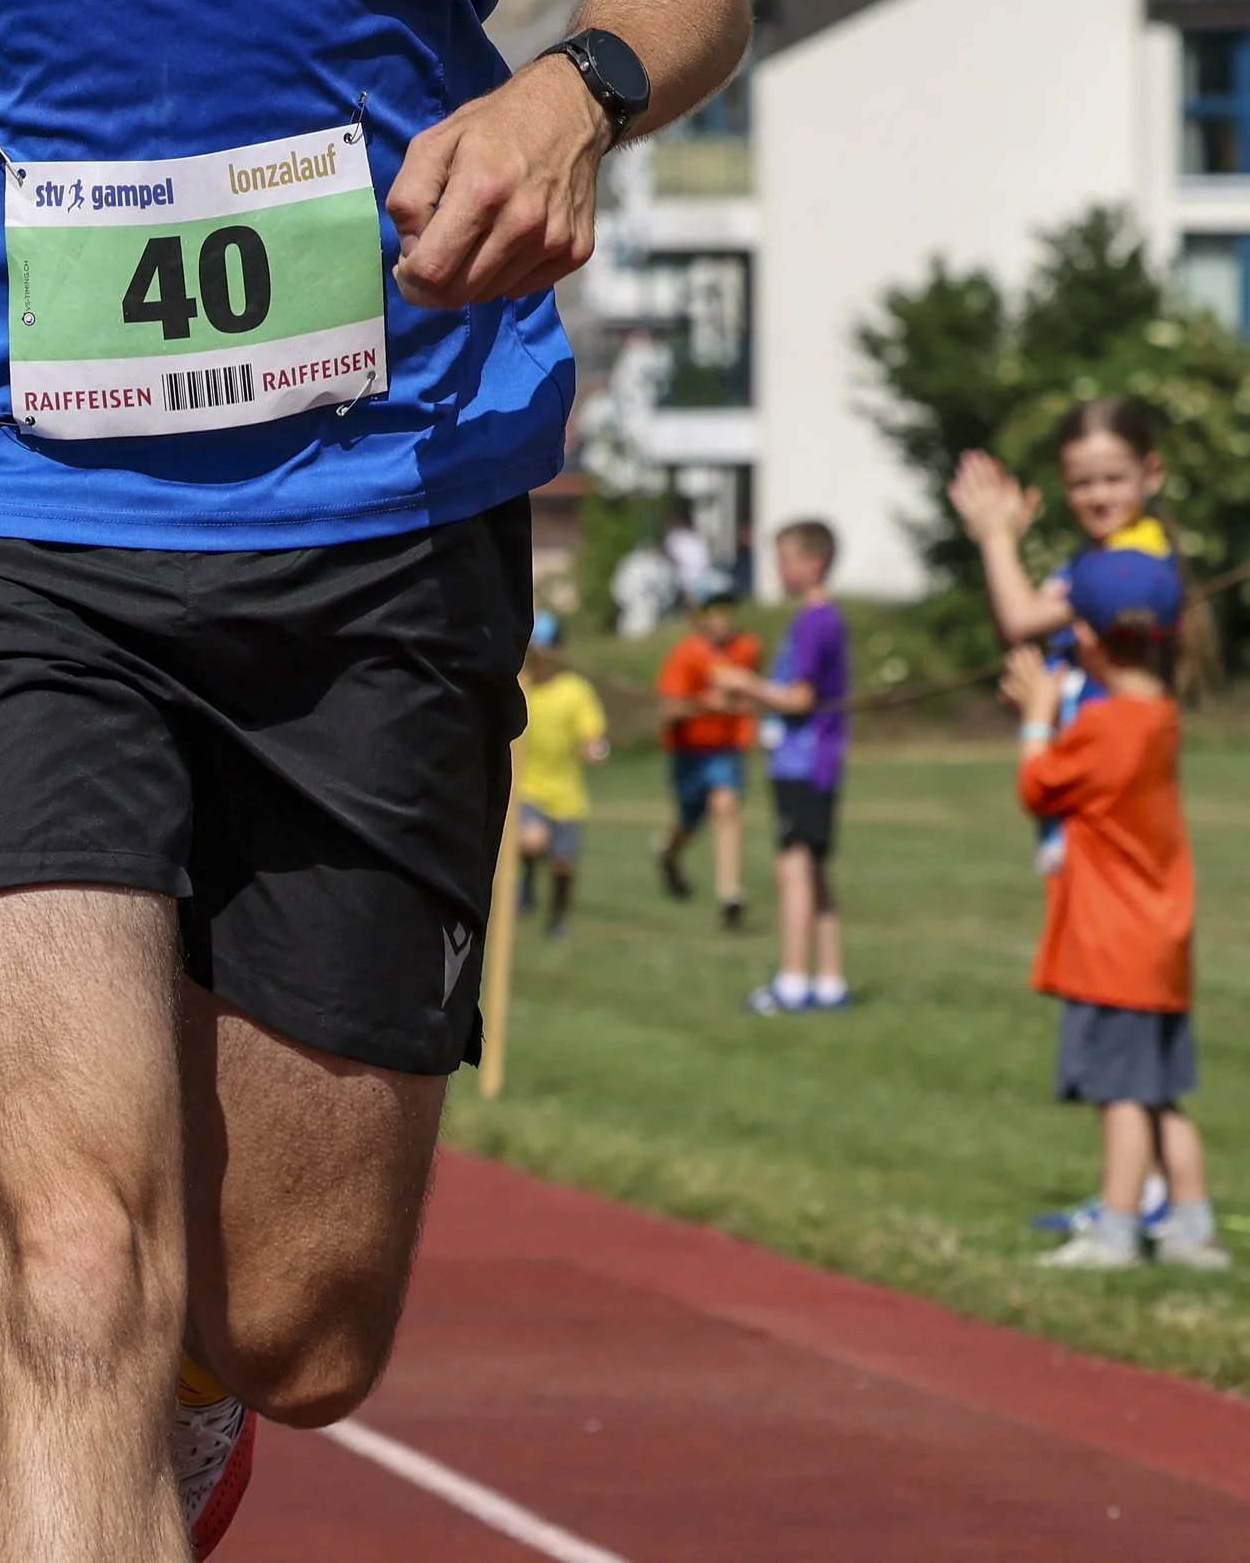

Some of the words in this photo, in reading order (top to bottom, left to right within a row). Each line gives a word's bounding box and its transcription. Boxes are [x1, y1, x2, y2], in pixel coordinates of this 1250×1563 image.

[228, 143, 336, 195] lonzalauf
[35, 181, 65, 207] stv
[91, 177, 174, 210] gampel
[23, 260, 31, 312] VS-TIMING.CH
[122, 225, 272, 340] 40
[262, 348, 377, 392] RAIFFEISEN
[24, 387, 152, 411] RAIFFEISEN
